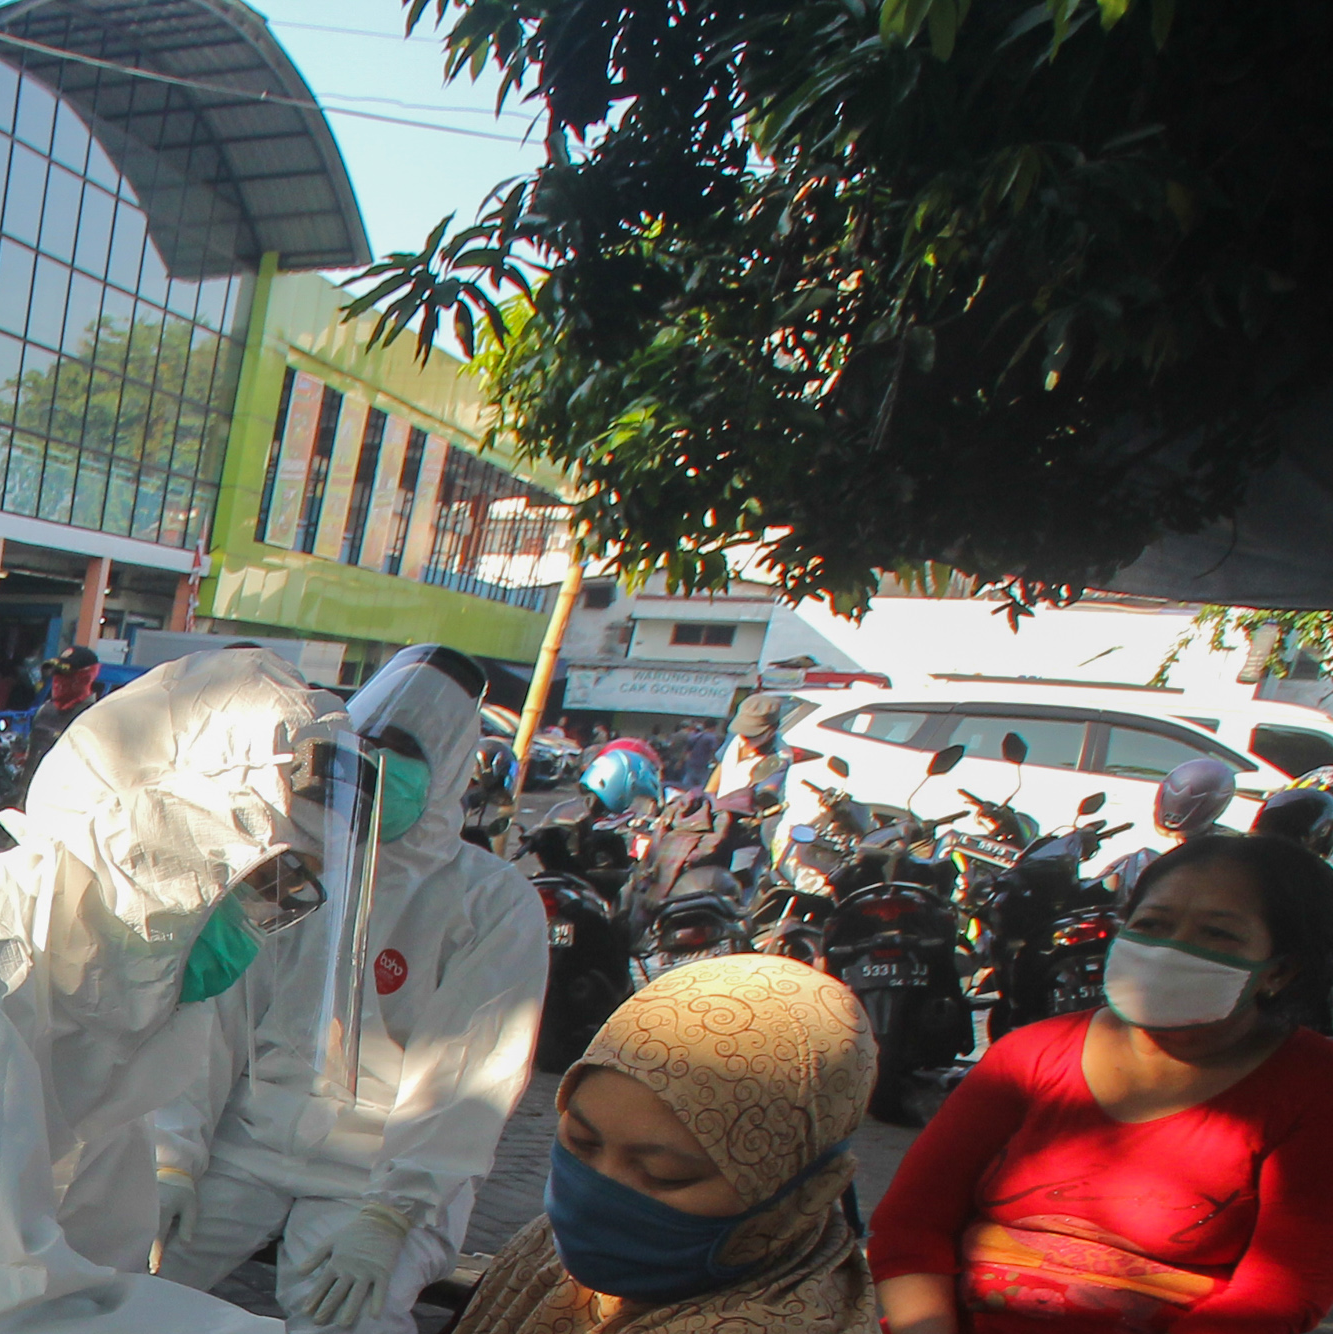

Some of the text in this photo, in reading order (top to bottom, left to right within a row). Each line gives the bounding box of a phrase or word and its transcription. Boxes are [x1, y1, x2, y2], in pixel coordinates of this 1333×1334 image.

[633, 670, 691, 683] WARUNG
[619, 683, 727, 699] CAK GONDRONG
[862, 963, 898, 977] 5331
